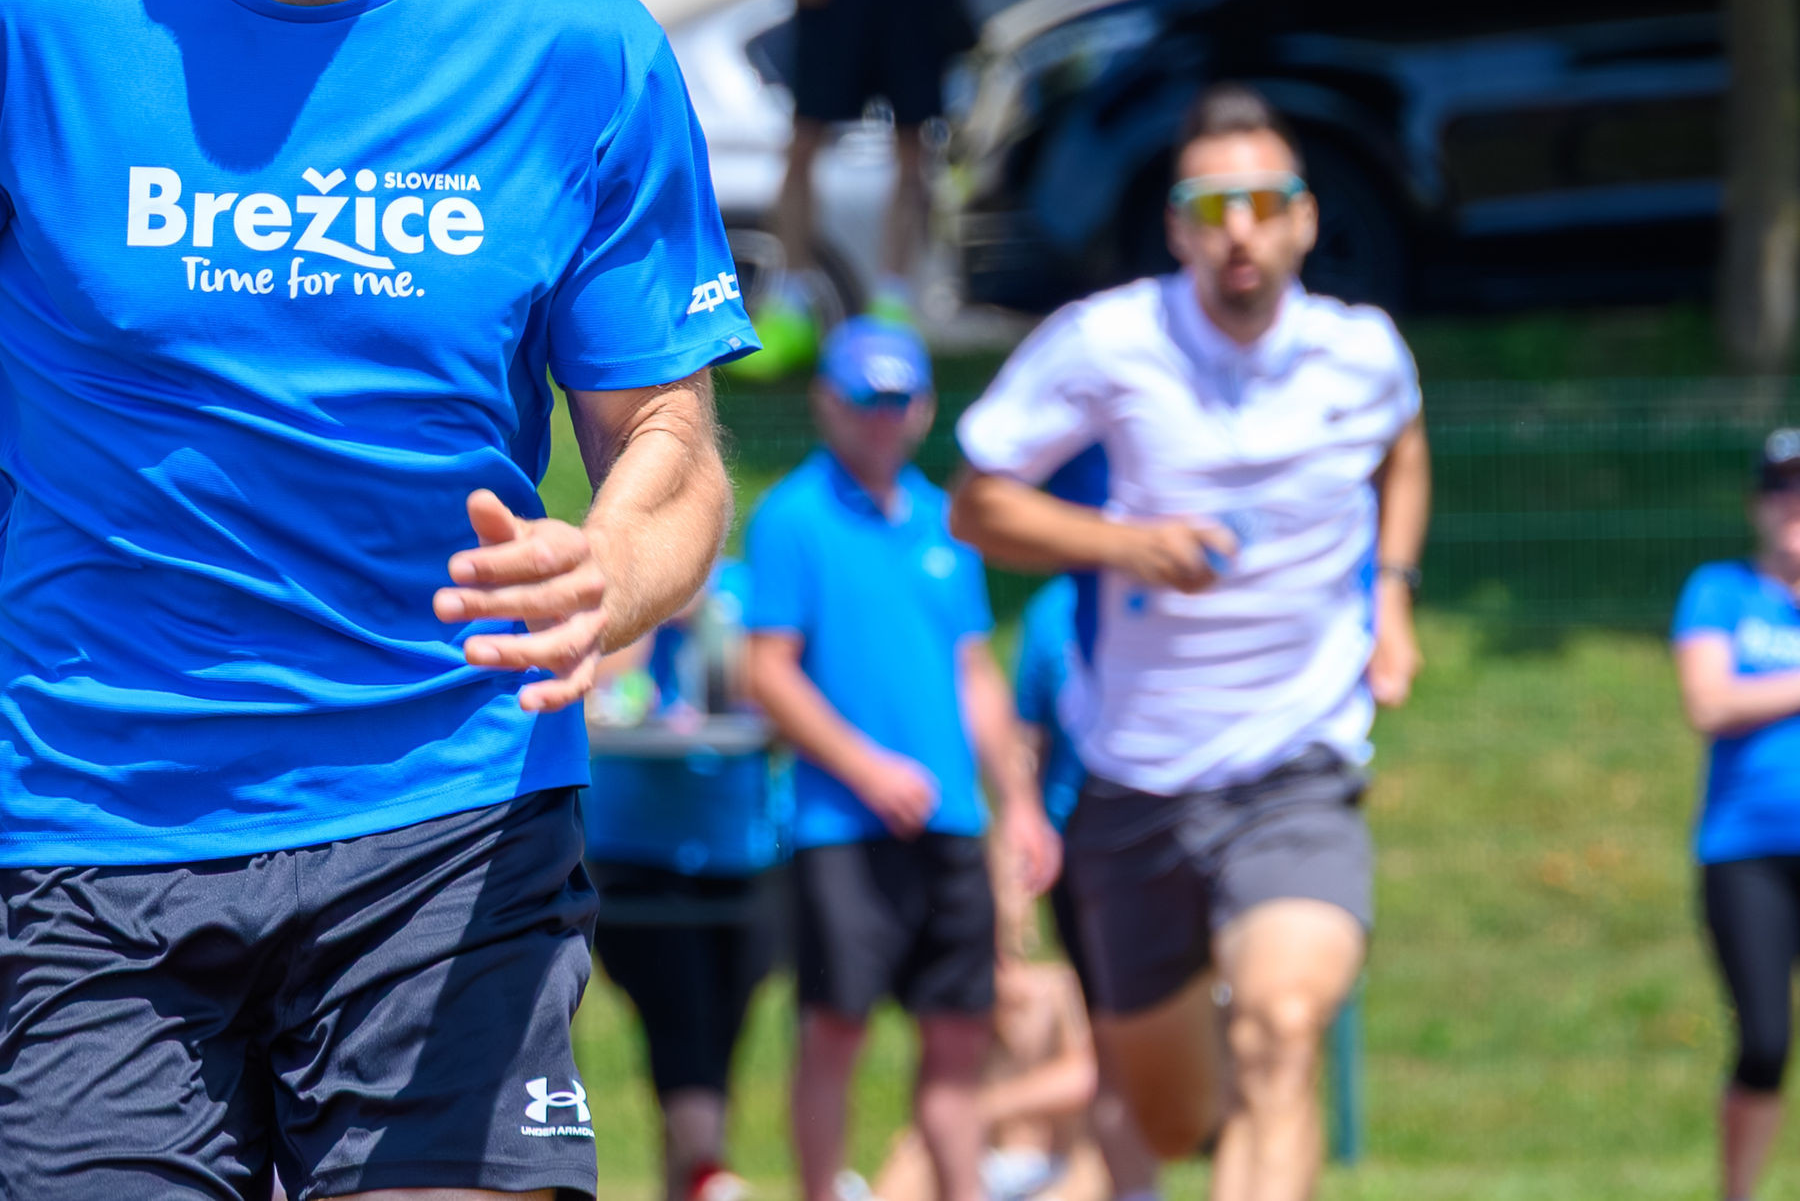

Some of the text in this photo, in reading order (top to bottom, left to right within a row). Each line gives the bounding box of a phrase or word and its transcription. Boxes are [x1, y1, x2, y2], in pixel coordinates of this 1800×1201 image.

[384, 171, 482, 192] SLOVENIA
[127, 166, 485, 270] Brežice
[181, 256, 425, 300] Time for me.
[686, 271, 741, 315] zpt
[521, 1125, 595, 1138] UNDER ARMOU
